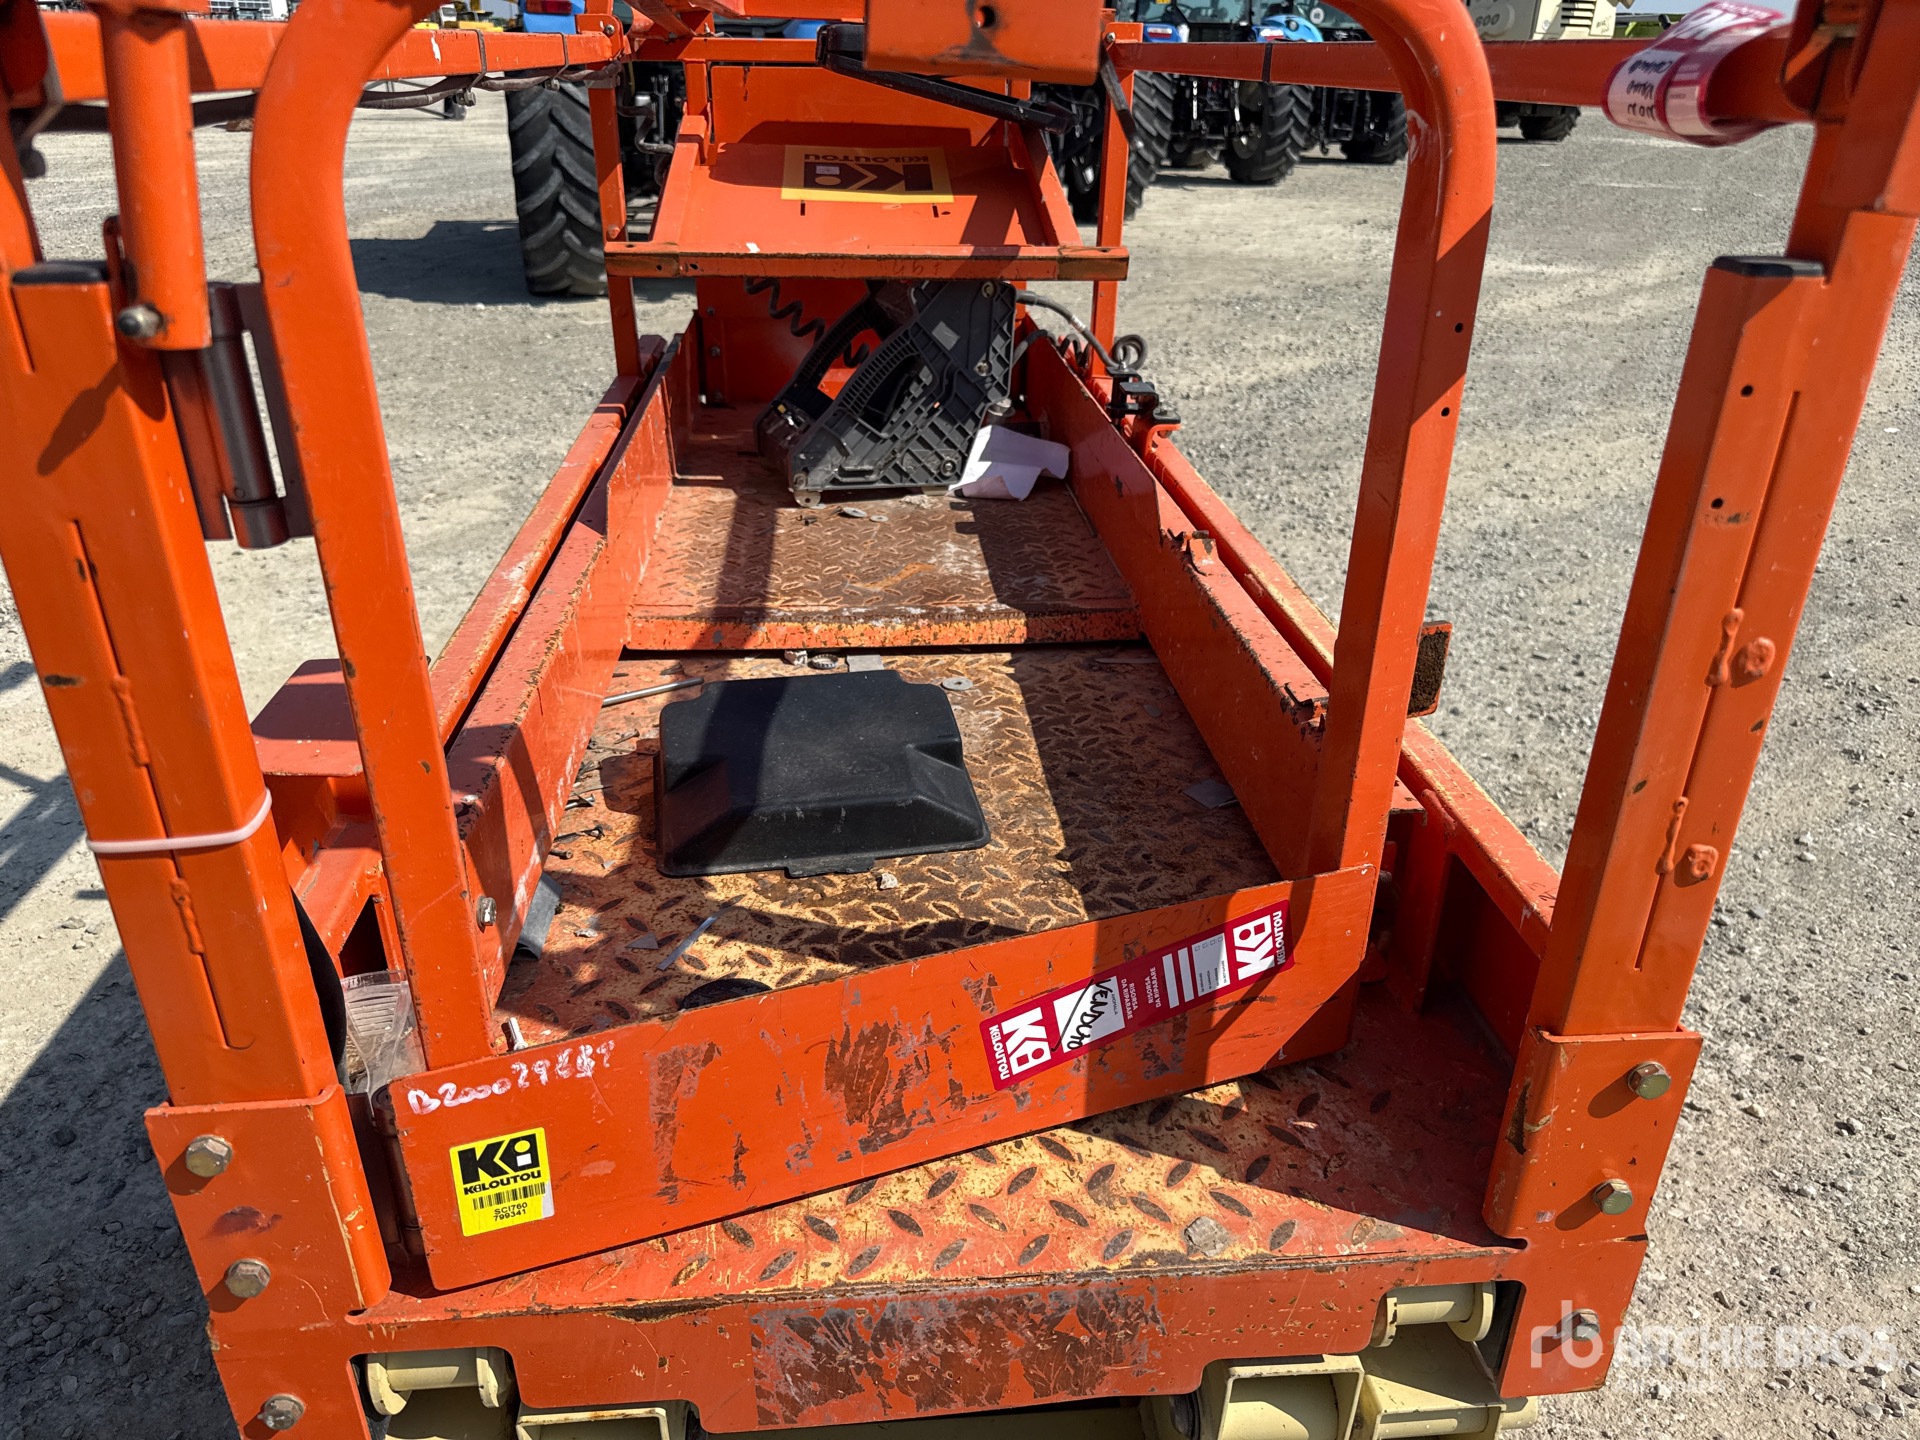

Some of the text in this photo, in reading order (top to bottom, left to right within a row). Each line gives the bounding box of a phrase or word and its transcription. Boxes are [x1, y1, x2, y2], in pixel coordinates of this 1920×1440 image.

[1128, 982, 1139, 1011] RISORSA
[1144, 975, 1154, 1004] RISORSA
[1149, 966, 1160, 998] RIPARARE
[1122, 988, 1134, 1020] RIPARARE
[493, 1208, 527, 1222] 799341
[494, 1201, 528, 1215] SCI760
